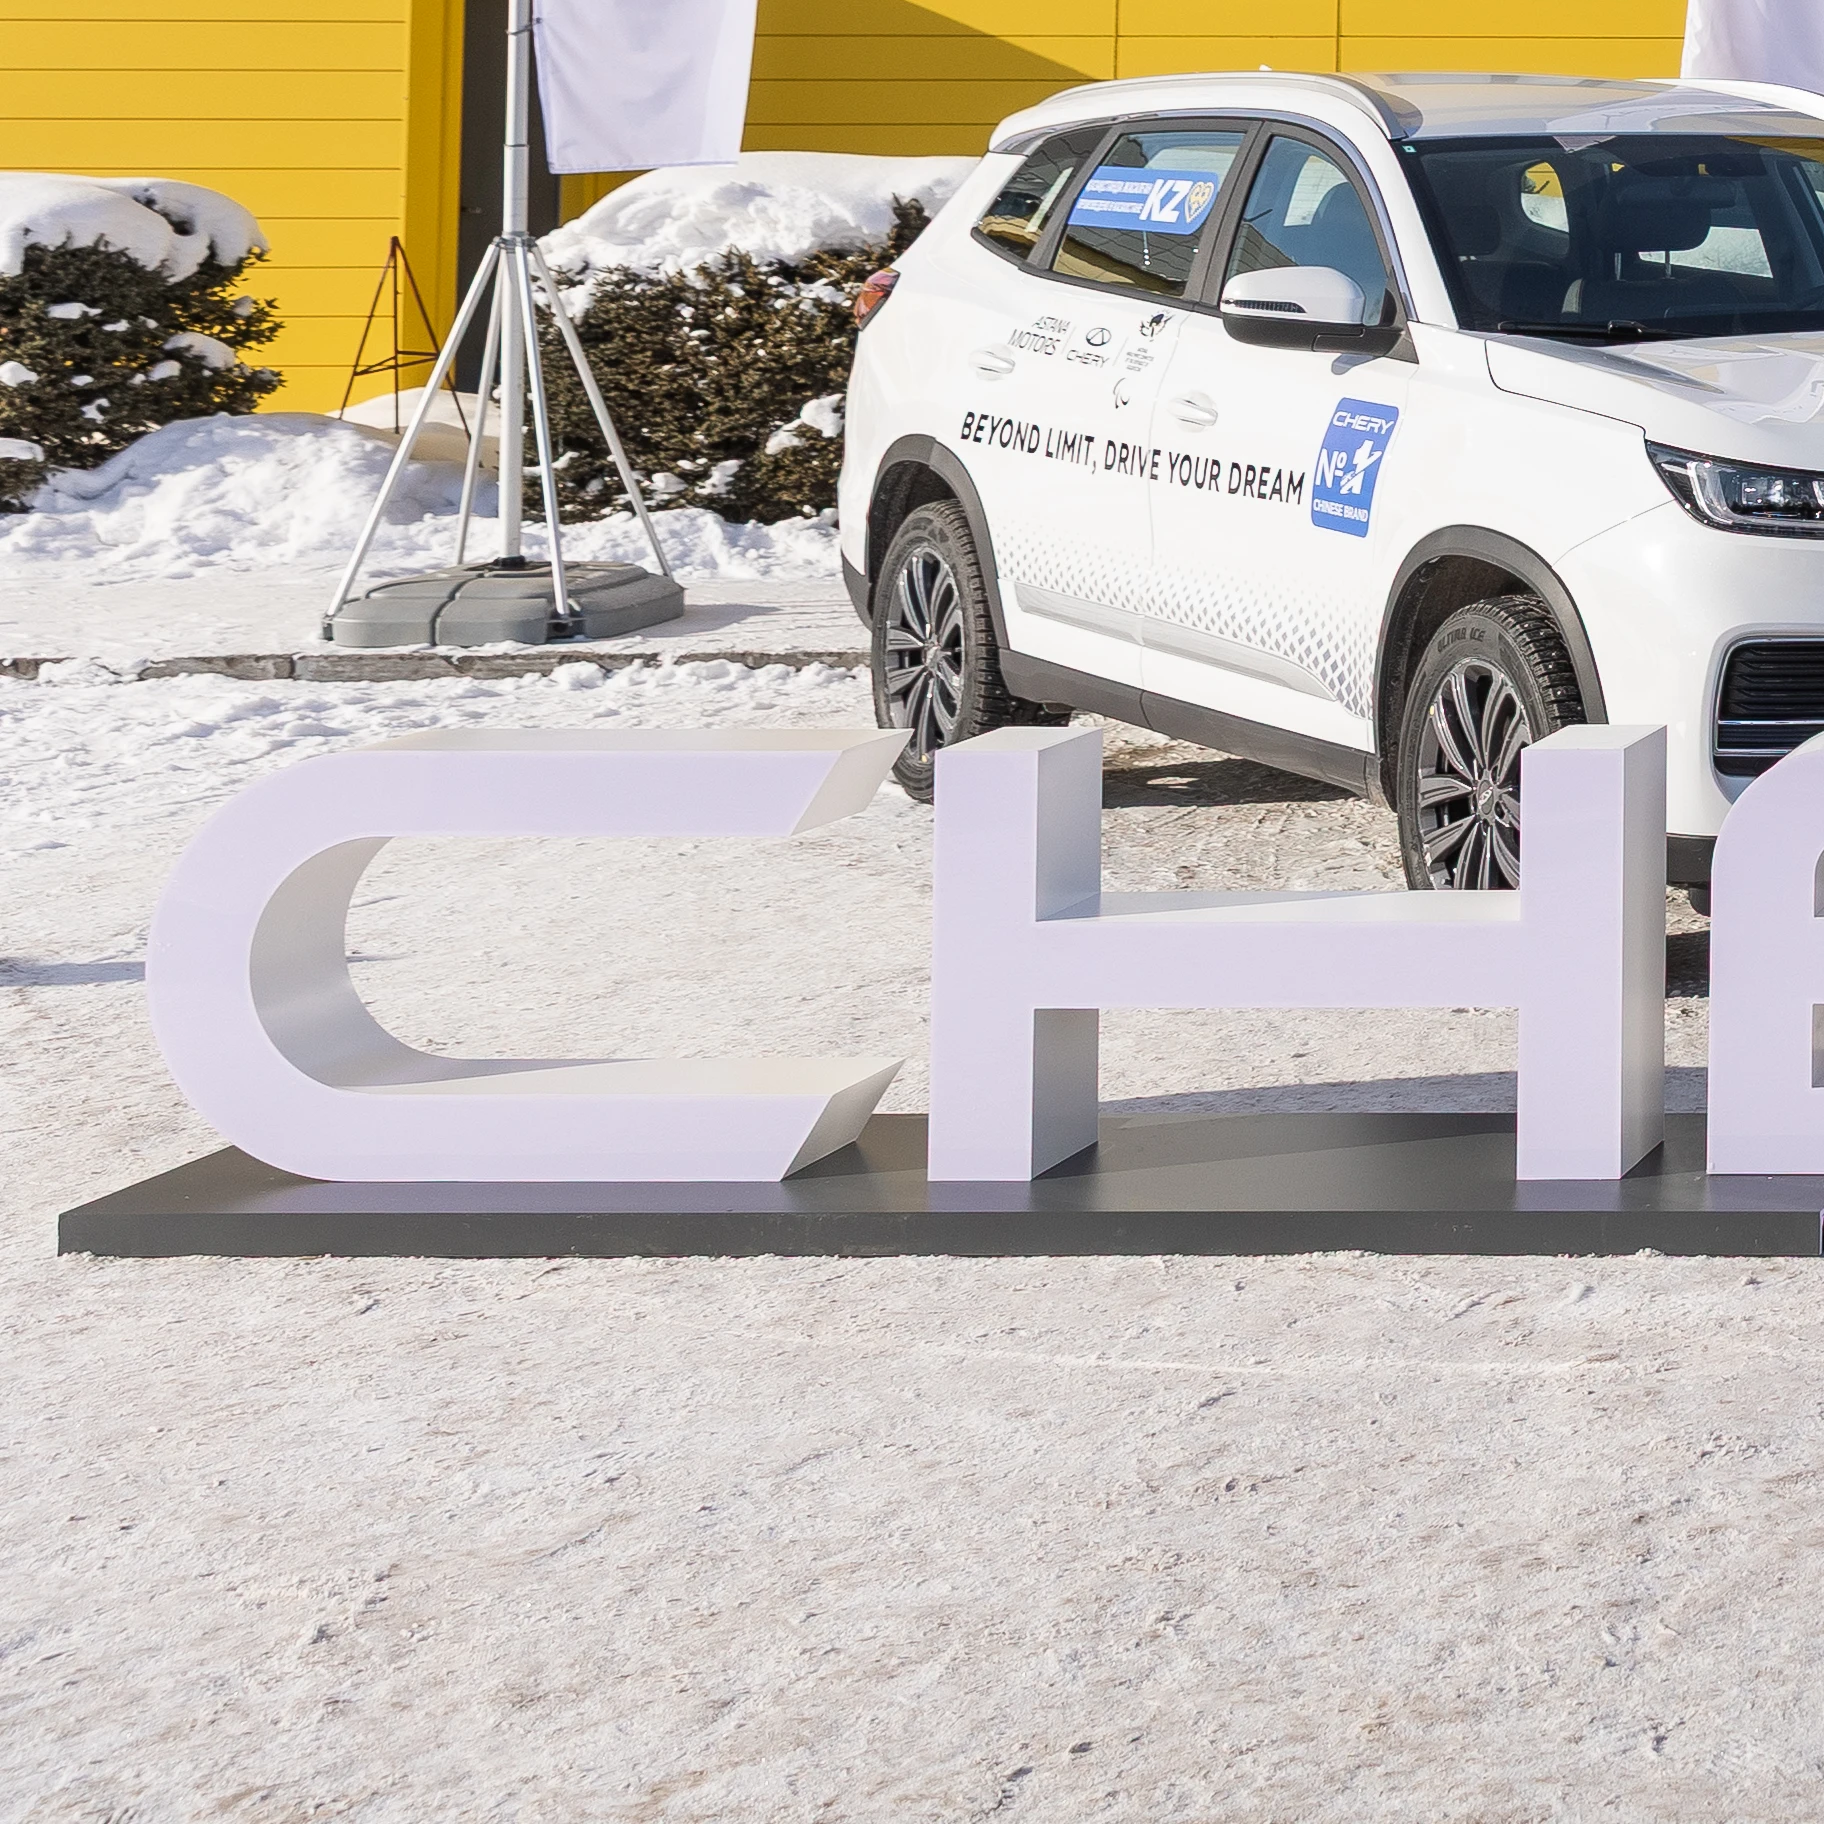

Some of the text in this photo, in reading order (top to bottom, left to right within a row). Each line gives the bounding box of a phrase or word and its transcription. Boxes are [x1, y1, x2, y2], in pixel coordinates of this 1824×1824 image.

[1139, 179, 1193, 223] KZ
[1007, 329, 1061, 356] MOTORS
[1066, 349, 1110, 368] CHERY
[1332, 411, 1394, 435] CHERY
[960, 411, 1305, 505] BEYOND LIMIT, DRIVE YOUR DREAM
[1313, 498, 1369, 522] CHINESE BRAND
